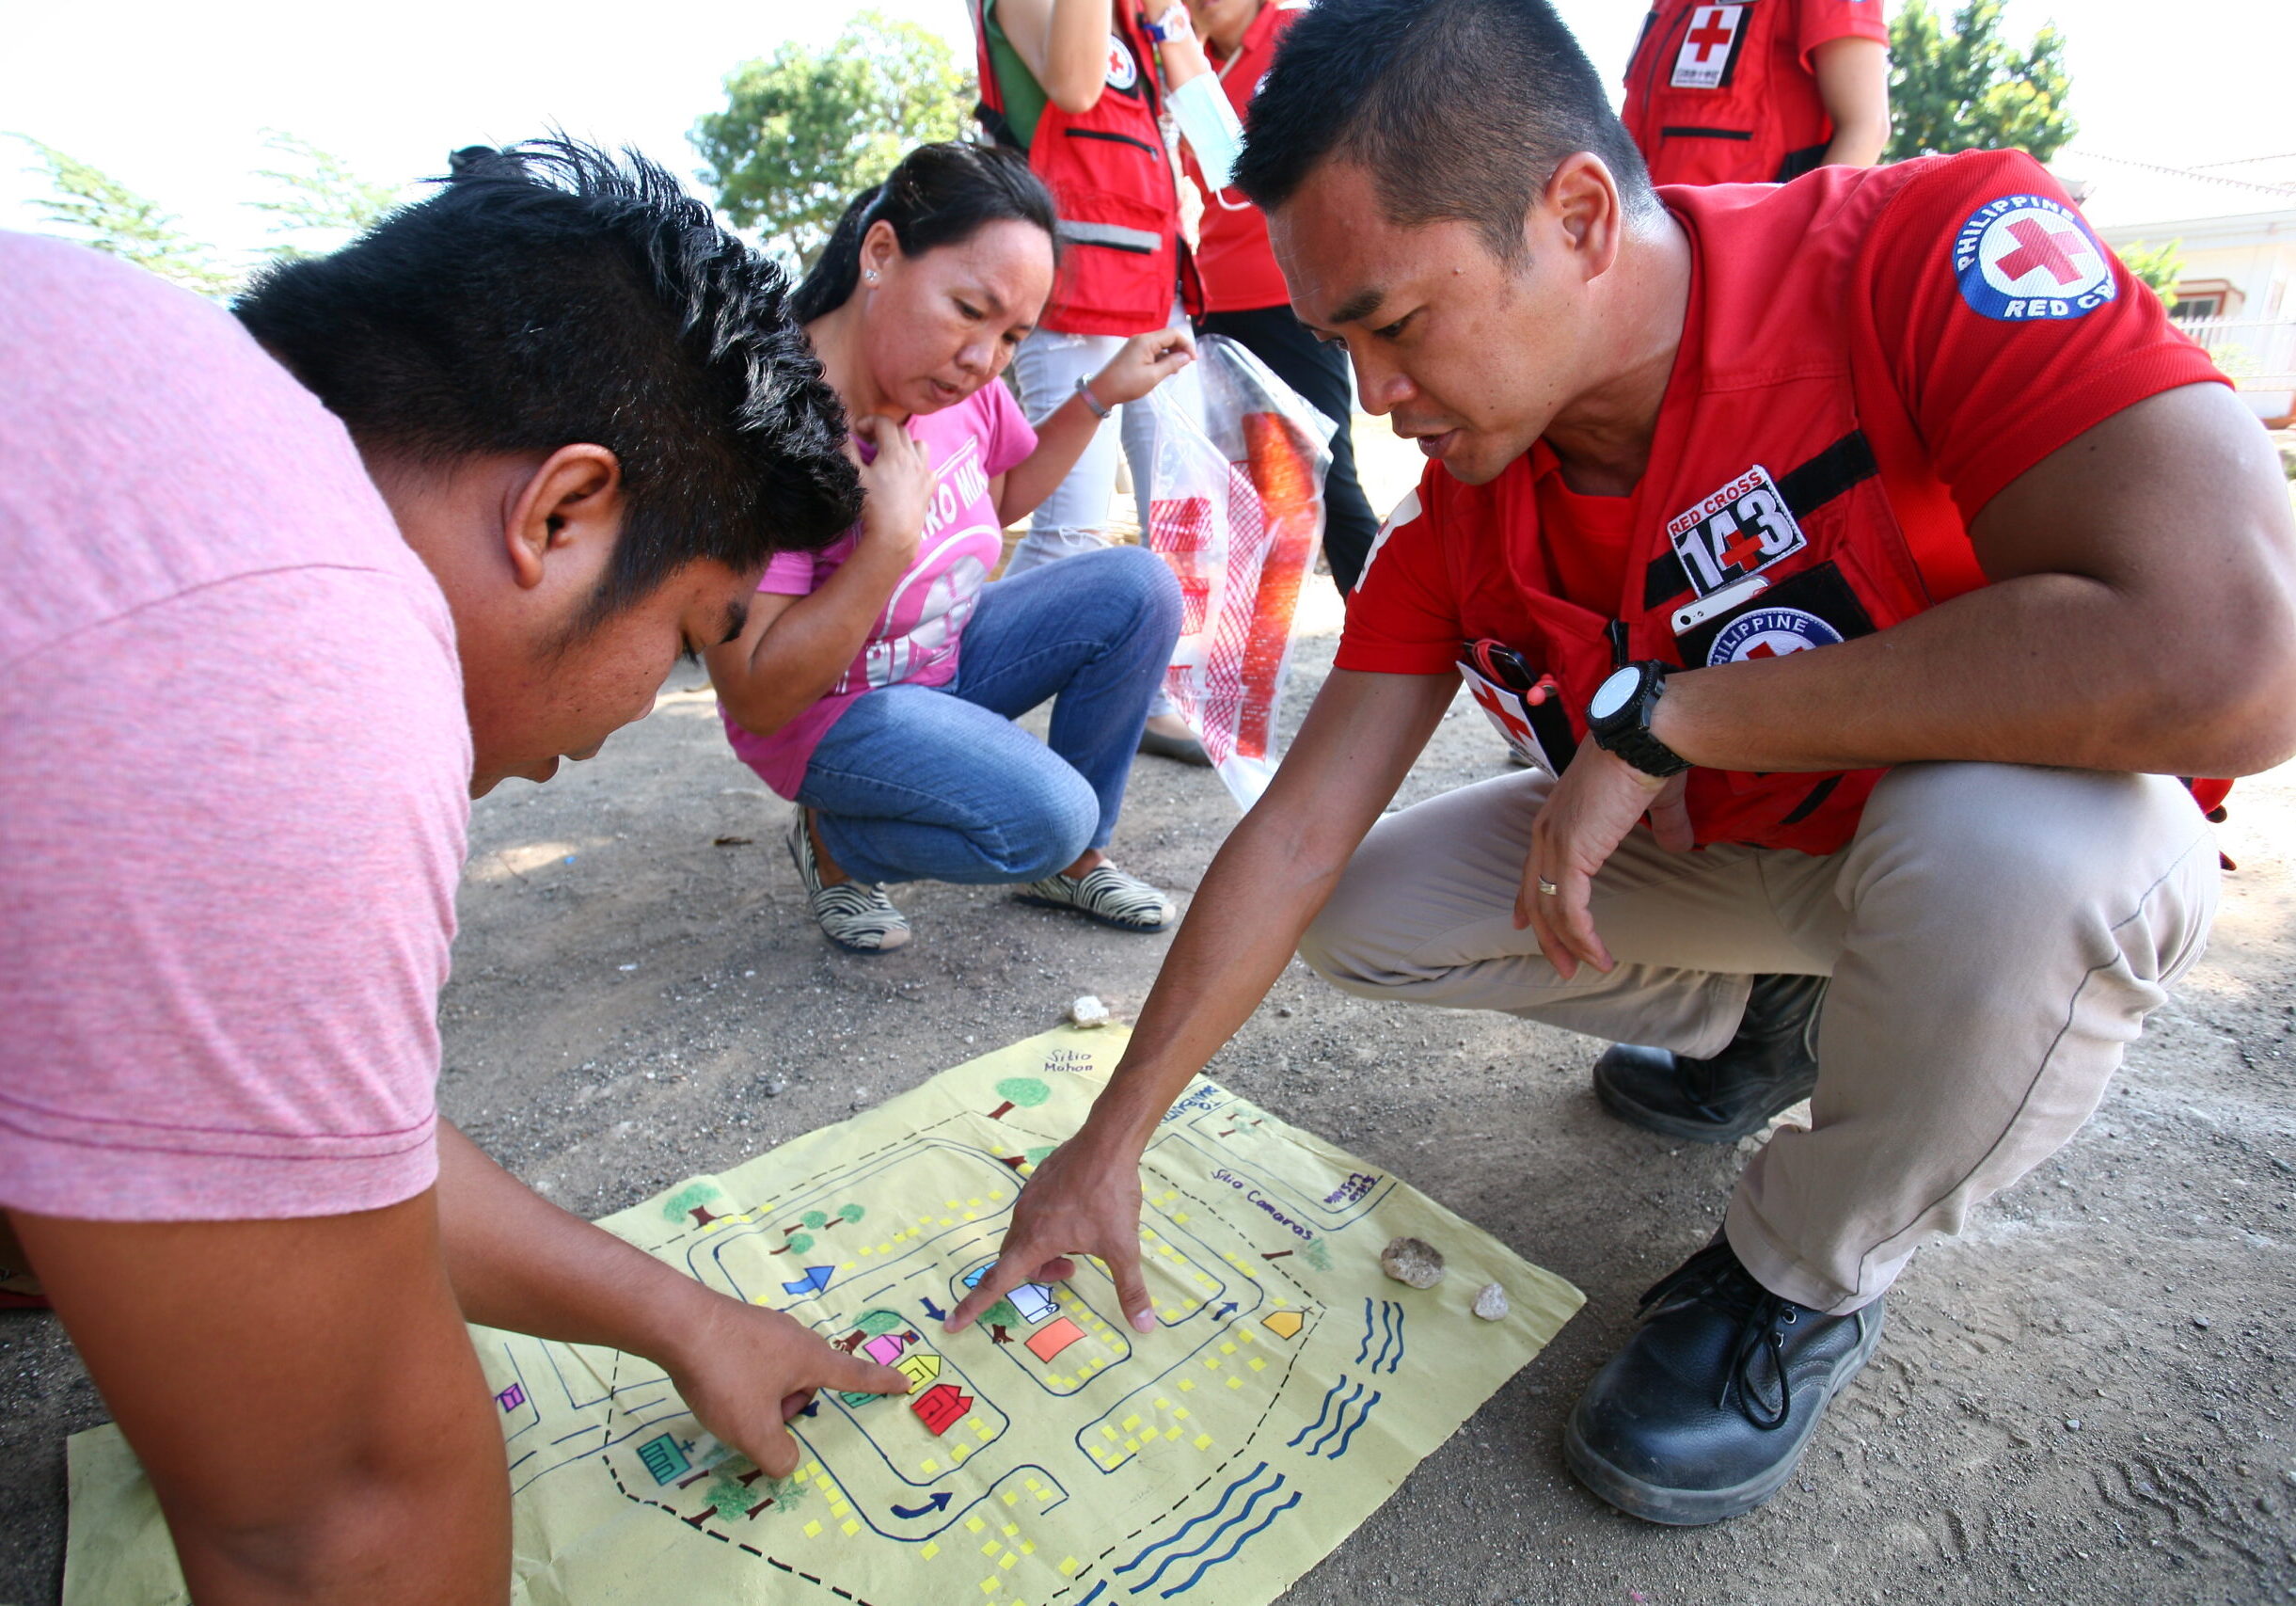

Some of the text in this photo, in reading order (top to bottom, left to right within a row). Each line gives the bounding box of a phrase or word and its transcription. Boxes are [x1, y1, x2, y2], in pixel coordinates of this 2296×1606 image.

[1957, 197, 2075, 271] PHILIPPINE
[2003, 299, 2068, 318] RED
[921, 483, 957, 539] RO
[1670, 471, 1763, 536] RED CROSS
[1678, 489, 1793, 589] 143
[1713, 615, 1808, 664] HILIPPINE
